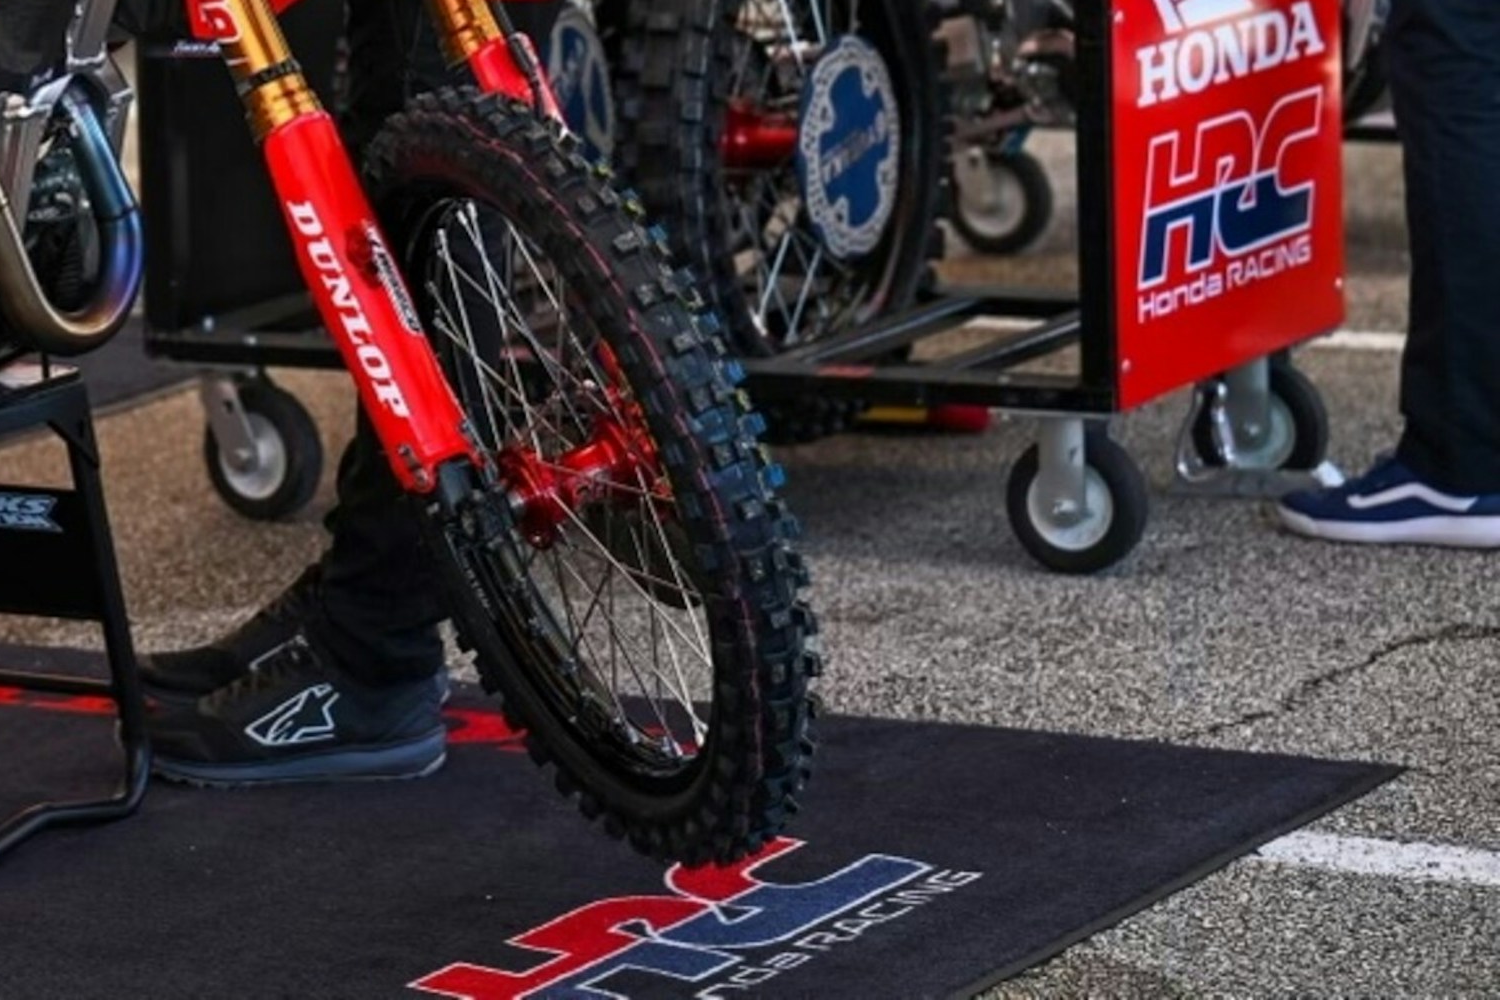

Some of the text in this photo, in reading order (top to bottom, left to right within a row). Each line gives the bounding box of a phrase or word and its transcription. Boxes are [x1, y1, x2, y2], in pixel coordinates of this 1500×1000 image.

[1136, 0, 1325, 108] HONDA
[1137, 84, 1324, 290] HRC
[286, 200, 411, 418] DUNLOP
[1137, 234, 1312, 324] Honda RACING
[809, 871, 964, 951] RACING
